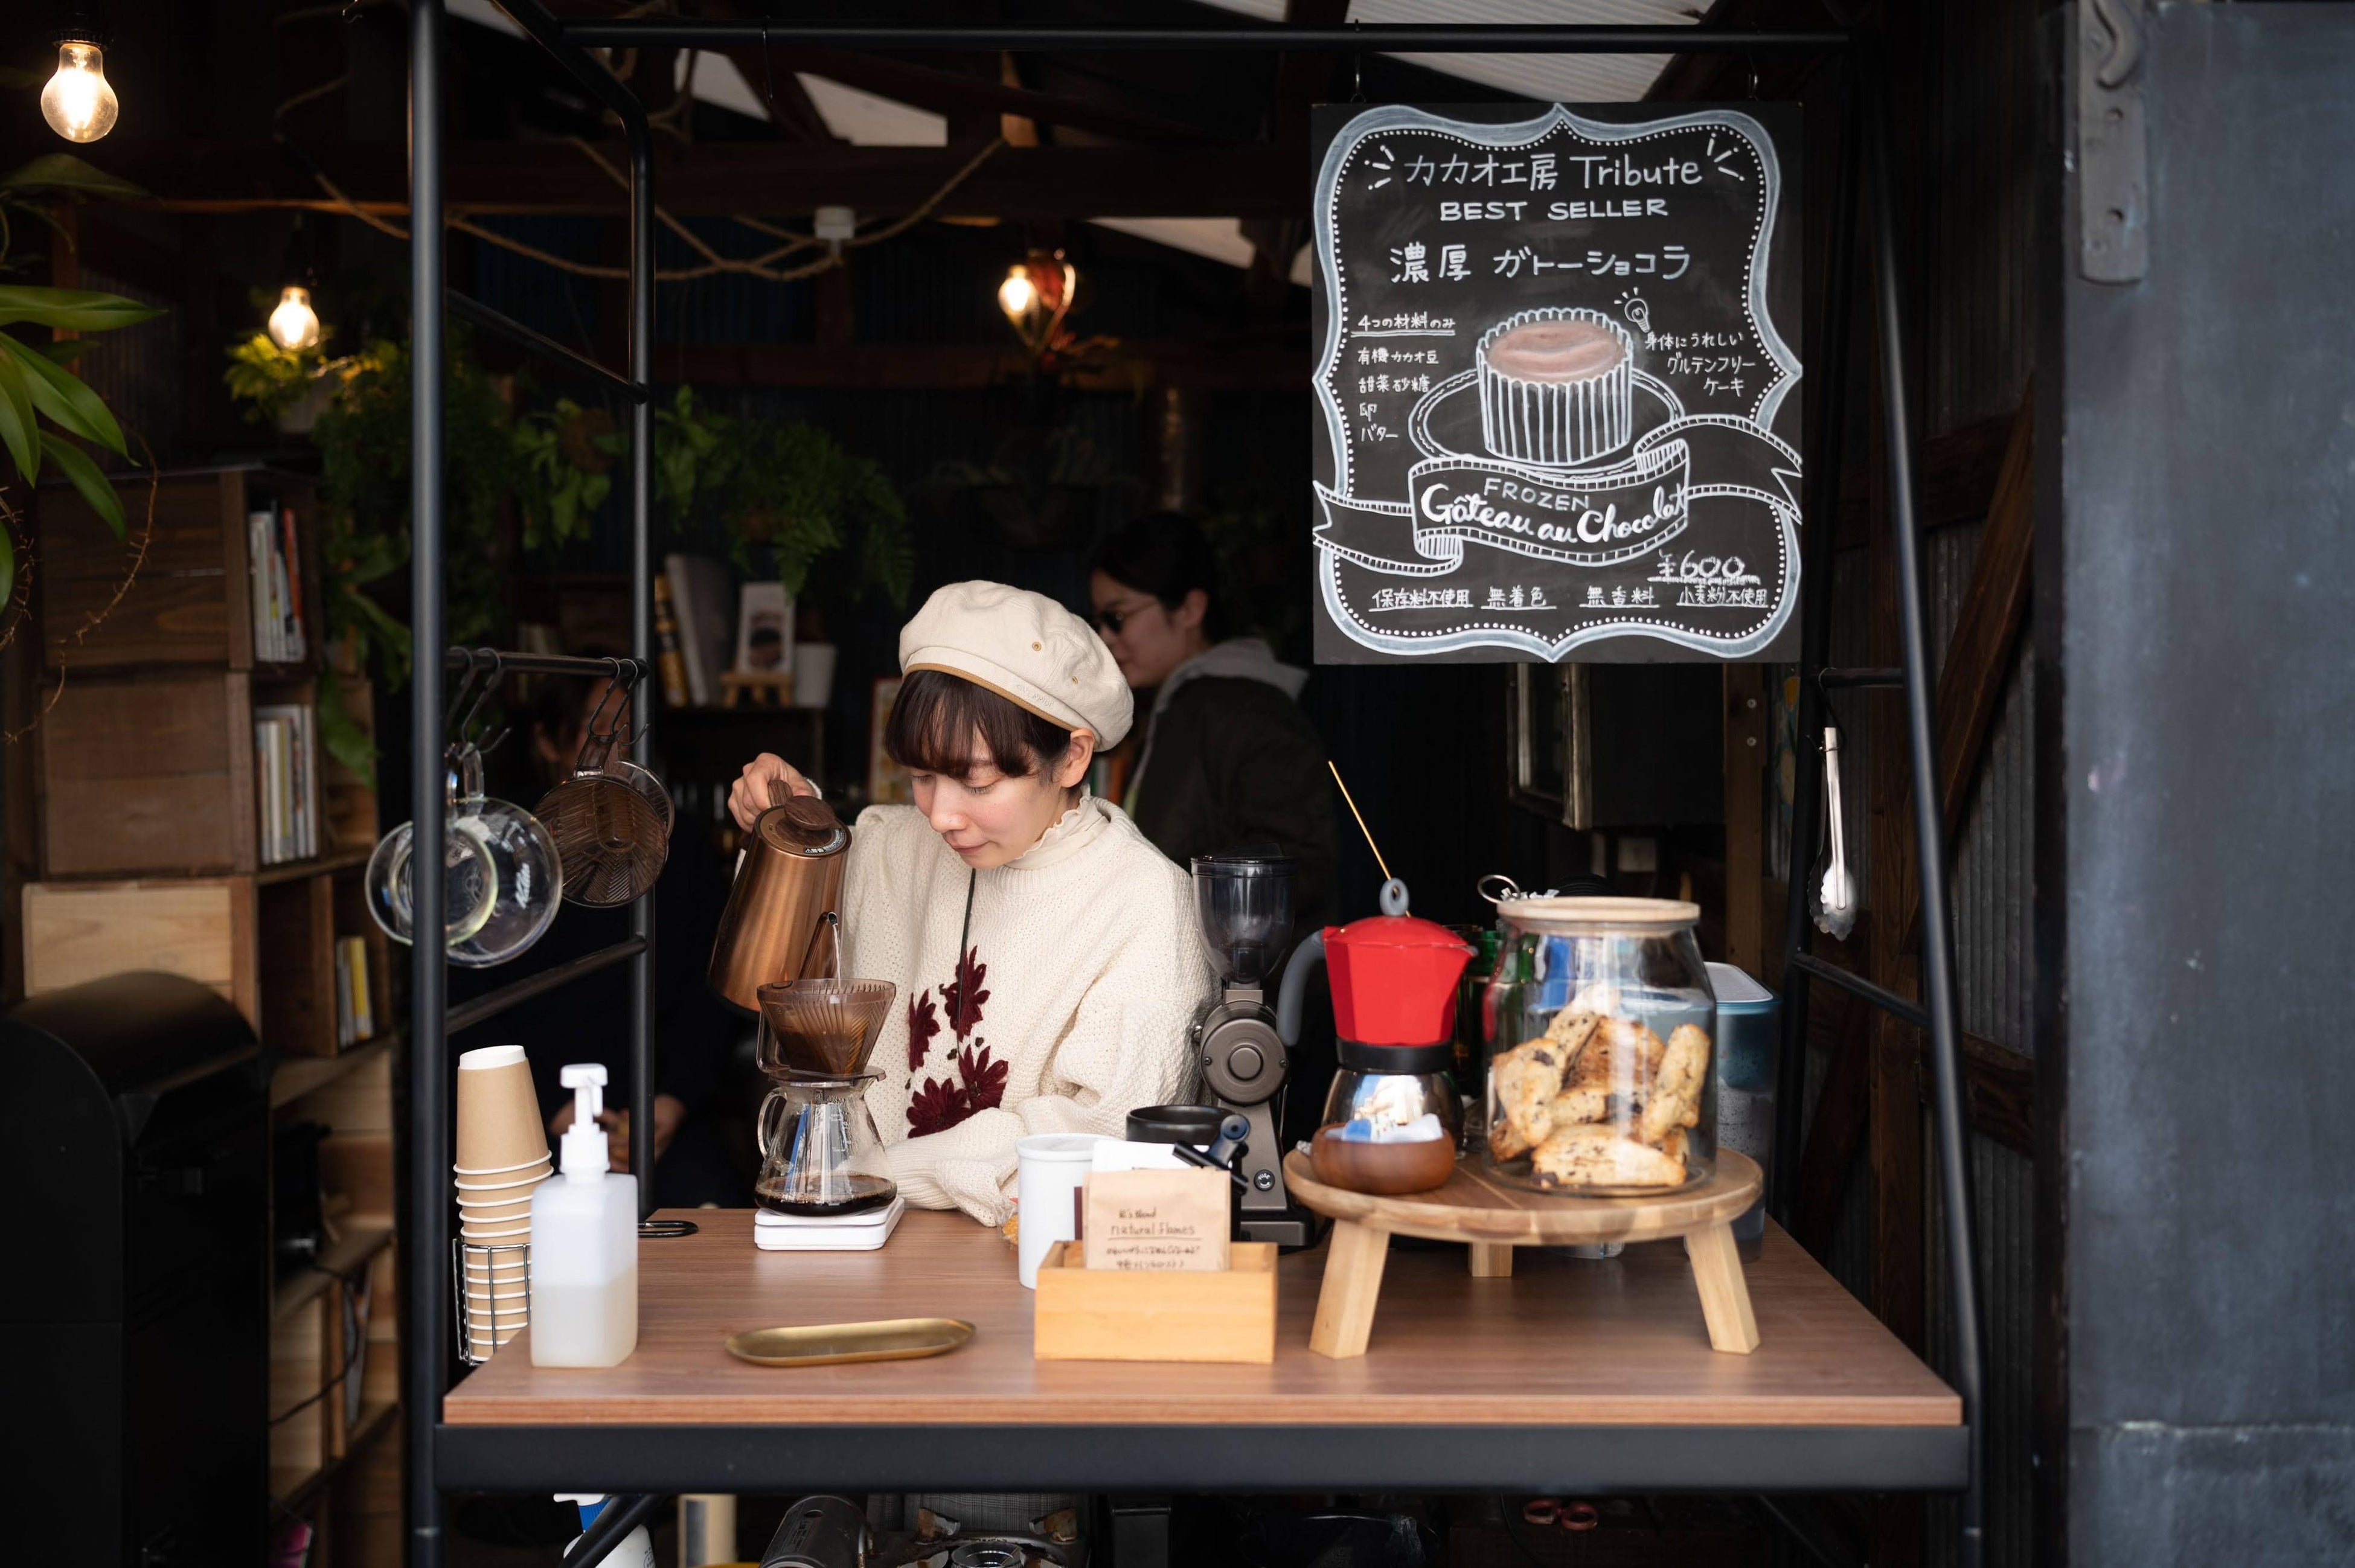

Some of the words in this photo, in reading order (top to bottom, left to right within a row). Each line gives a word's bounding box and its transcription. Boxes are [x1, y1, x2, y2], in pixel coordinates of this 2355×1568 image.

[1404, 153, 1558, 191] カカオ工房
[1569, 153, 1703, 189] Tribute
[1440, 202, 1528, 221] BEST
[1548, 199, 1668, 220] SELLER
[1389, 242, 1472, 283] 濃厚
[1493, 245, 1690, 280] ガトーショコラ
[1357, 311, 1456, 331] 4つの材料のみ
[1644, 331, 1744, 351] 身体にうれしい
[1357, 346, 1439, 365] 有機カカオ豆
[1667, 351, 1756, 374] グルテンフリー
[1703, 377, 1744, 397] ケーキ
[1360, 423, 1399, 442] バター
[1483, 477, 1589, 511] FROZEN
[1420, 483, 1534, 536] Gâteau
[1537, 523, 1578, 543] au
[1576, 482, 1685, 543] Chocolat
[1656, 549, 1746, 584] ¥600
[1372, 587, 1470, 607] 保存料不使用
[1487, 584, 1547, 607] 無着色
[1587, 585, 1655, 606] 無香料
[1679, 583, 1767, 606] 小麦粉不使用
